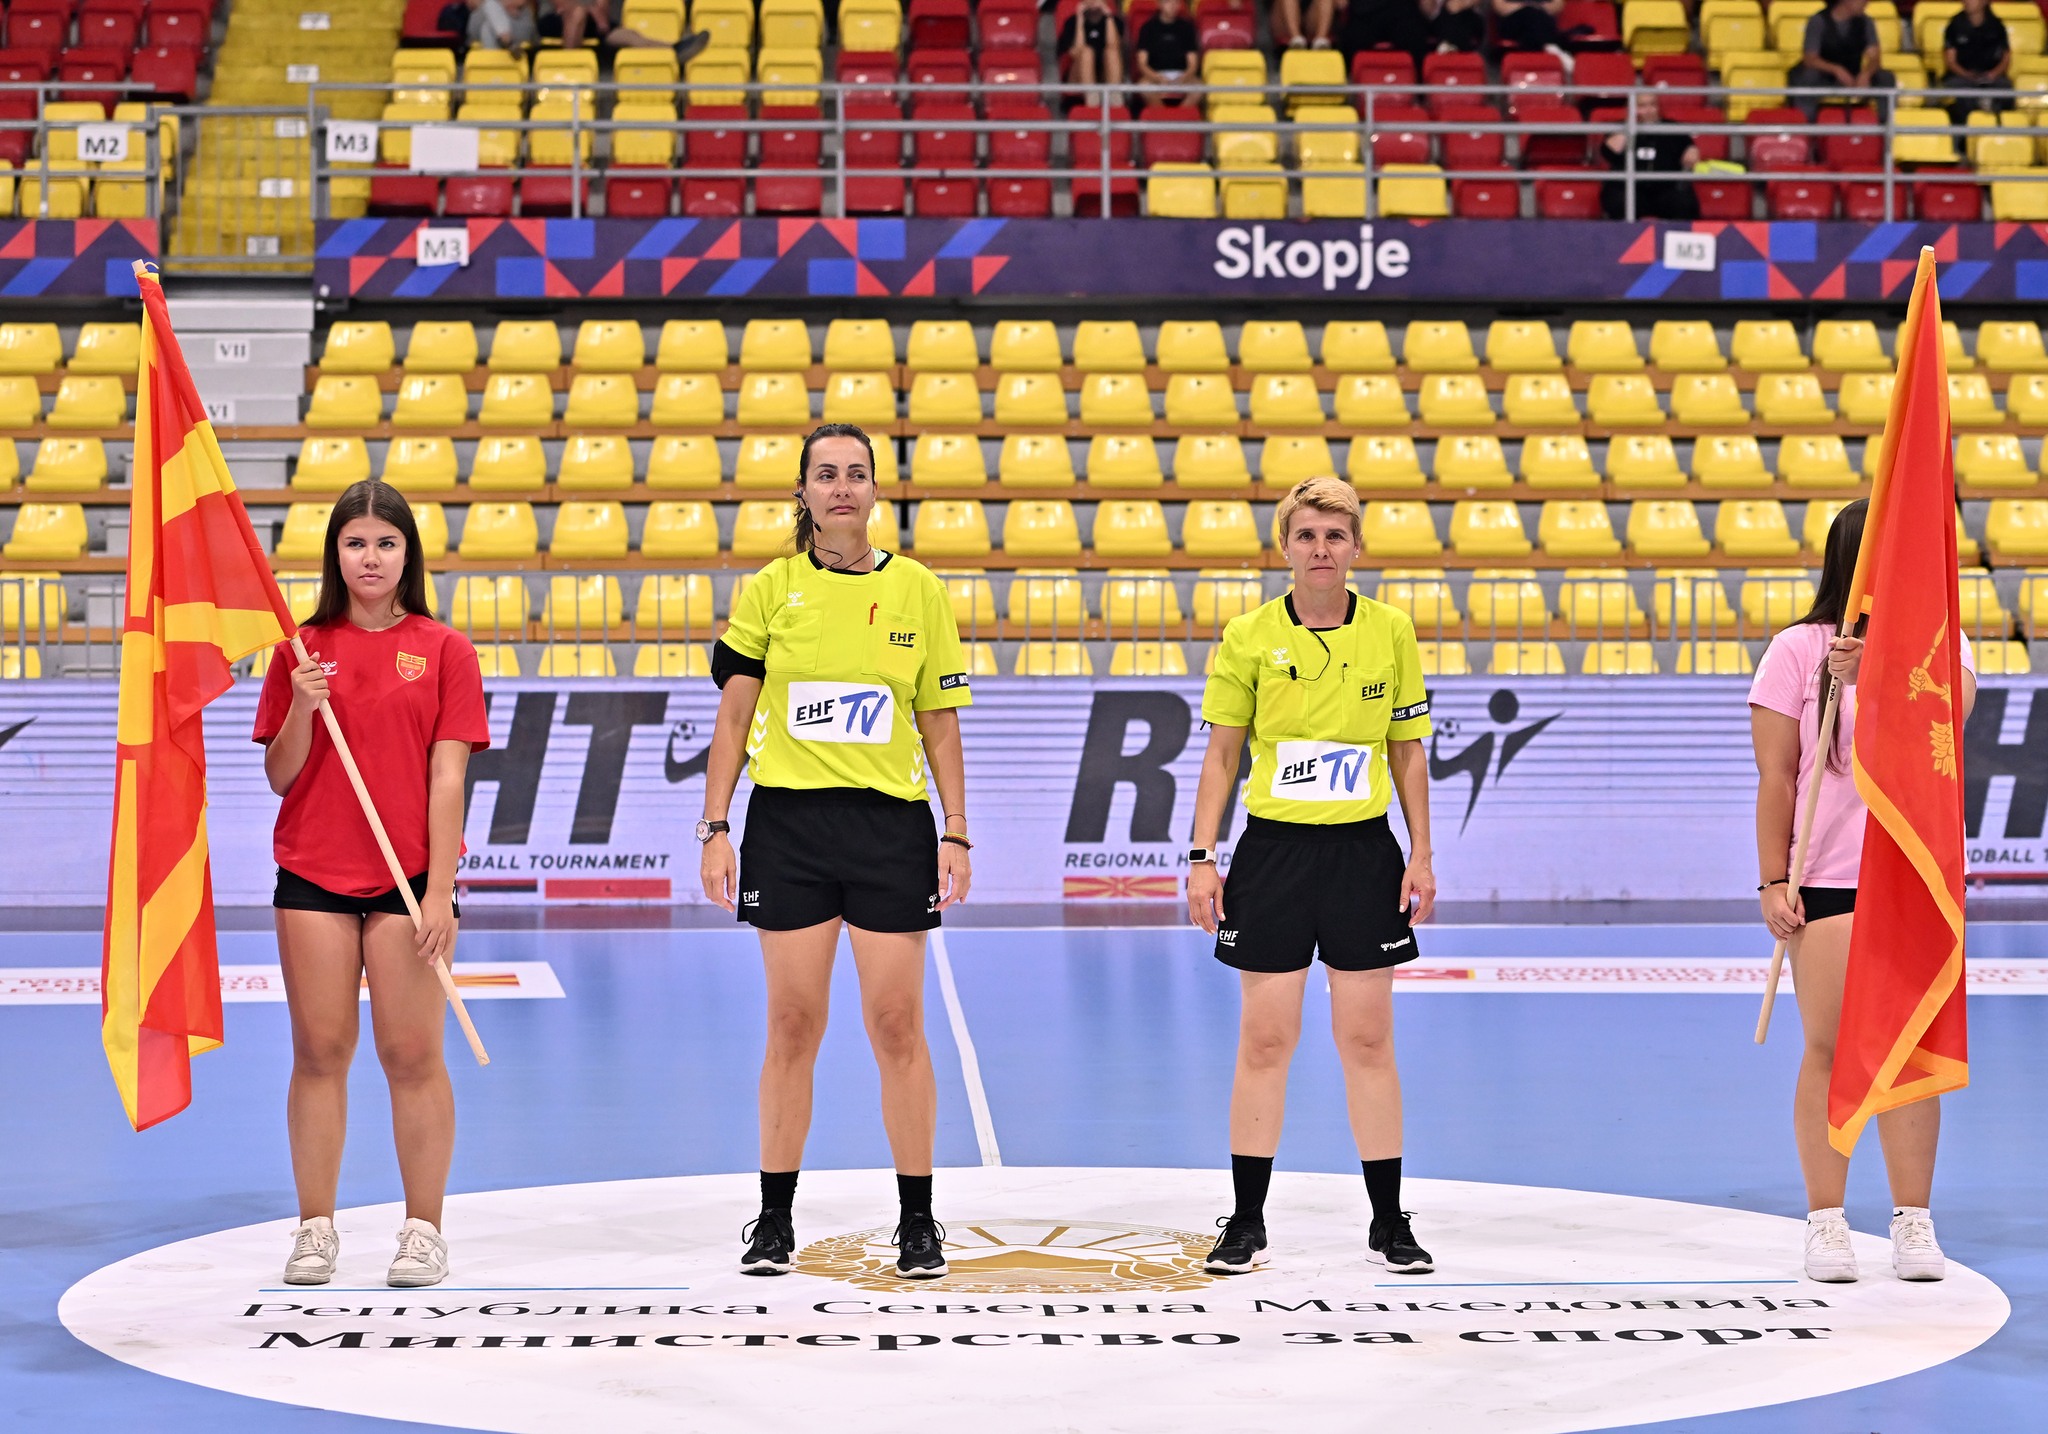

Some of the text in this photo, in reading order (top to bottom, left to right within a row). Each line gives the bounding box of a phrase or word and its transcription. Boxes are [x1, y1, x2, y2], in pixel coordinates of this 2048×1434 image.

[85, 137, 120, 156] M2
[335, 134, 369, 153] M3
[423, 238, 462, 260] M3
[1213, 224, 1412, 291] Skopje
[1675, 242, 1706, 261] M3
[220, 343, 246, 358] VII
[889, 632, 917, 643] EHF
[942, 675, 956, 687] EHF
[1361, 682, 1387, 699] EHF
[795, 691, 889, 737] EHF TV
[1281, 748, 1367, 793] EHF TV
[529, 854, 671, 870] TOURNAMENT
[1064, 853, 1169, 868] REGIONAL
[743, 890, 760, 903] EHF
[1219, 930, 1239, 942] EHF
[235, 1296, 1834, 1320] Република Северна Македонија
[248, 1327, 1833, 1351] Министерство за спорт
